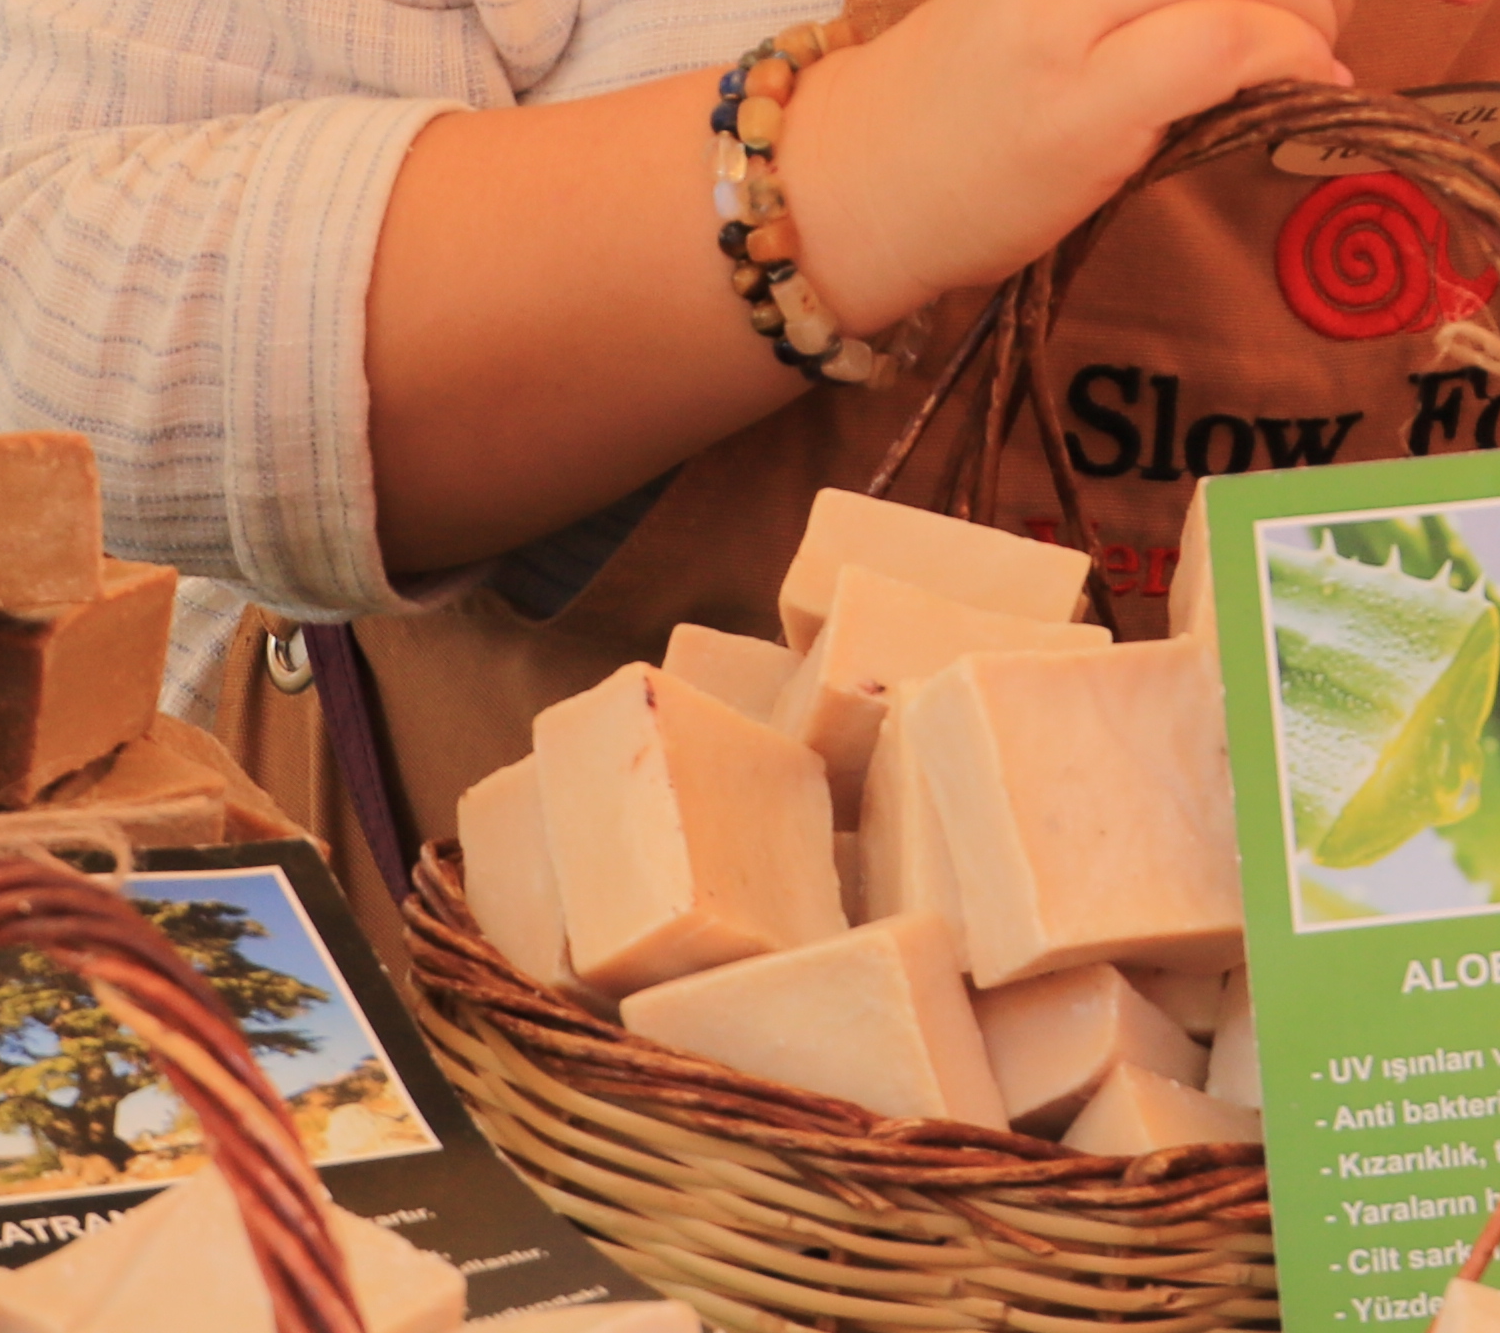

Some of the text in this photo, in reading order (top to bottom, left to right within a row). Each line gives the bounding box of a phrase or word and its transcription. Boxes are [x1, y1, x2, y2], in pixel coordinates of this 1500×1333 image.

[1065, 363, 1363, 481] Slow
[1328, 1054, 1374, 1084] UV
[1381, 1047, 1485, 1083] ışınları
[1332, 1102, 1396, 1131] Anti
[1338, 1141, 1488, 1179] Kızarıklık,
[1342, 1192, 1478, 1227] Yaraların
[1347, 1245, 1401, 1276] Cilt
